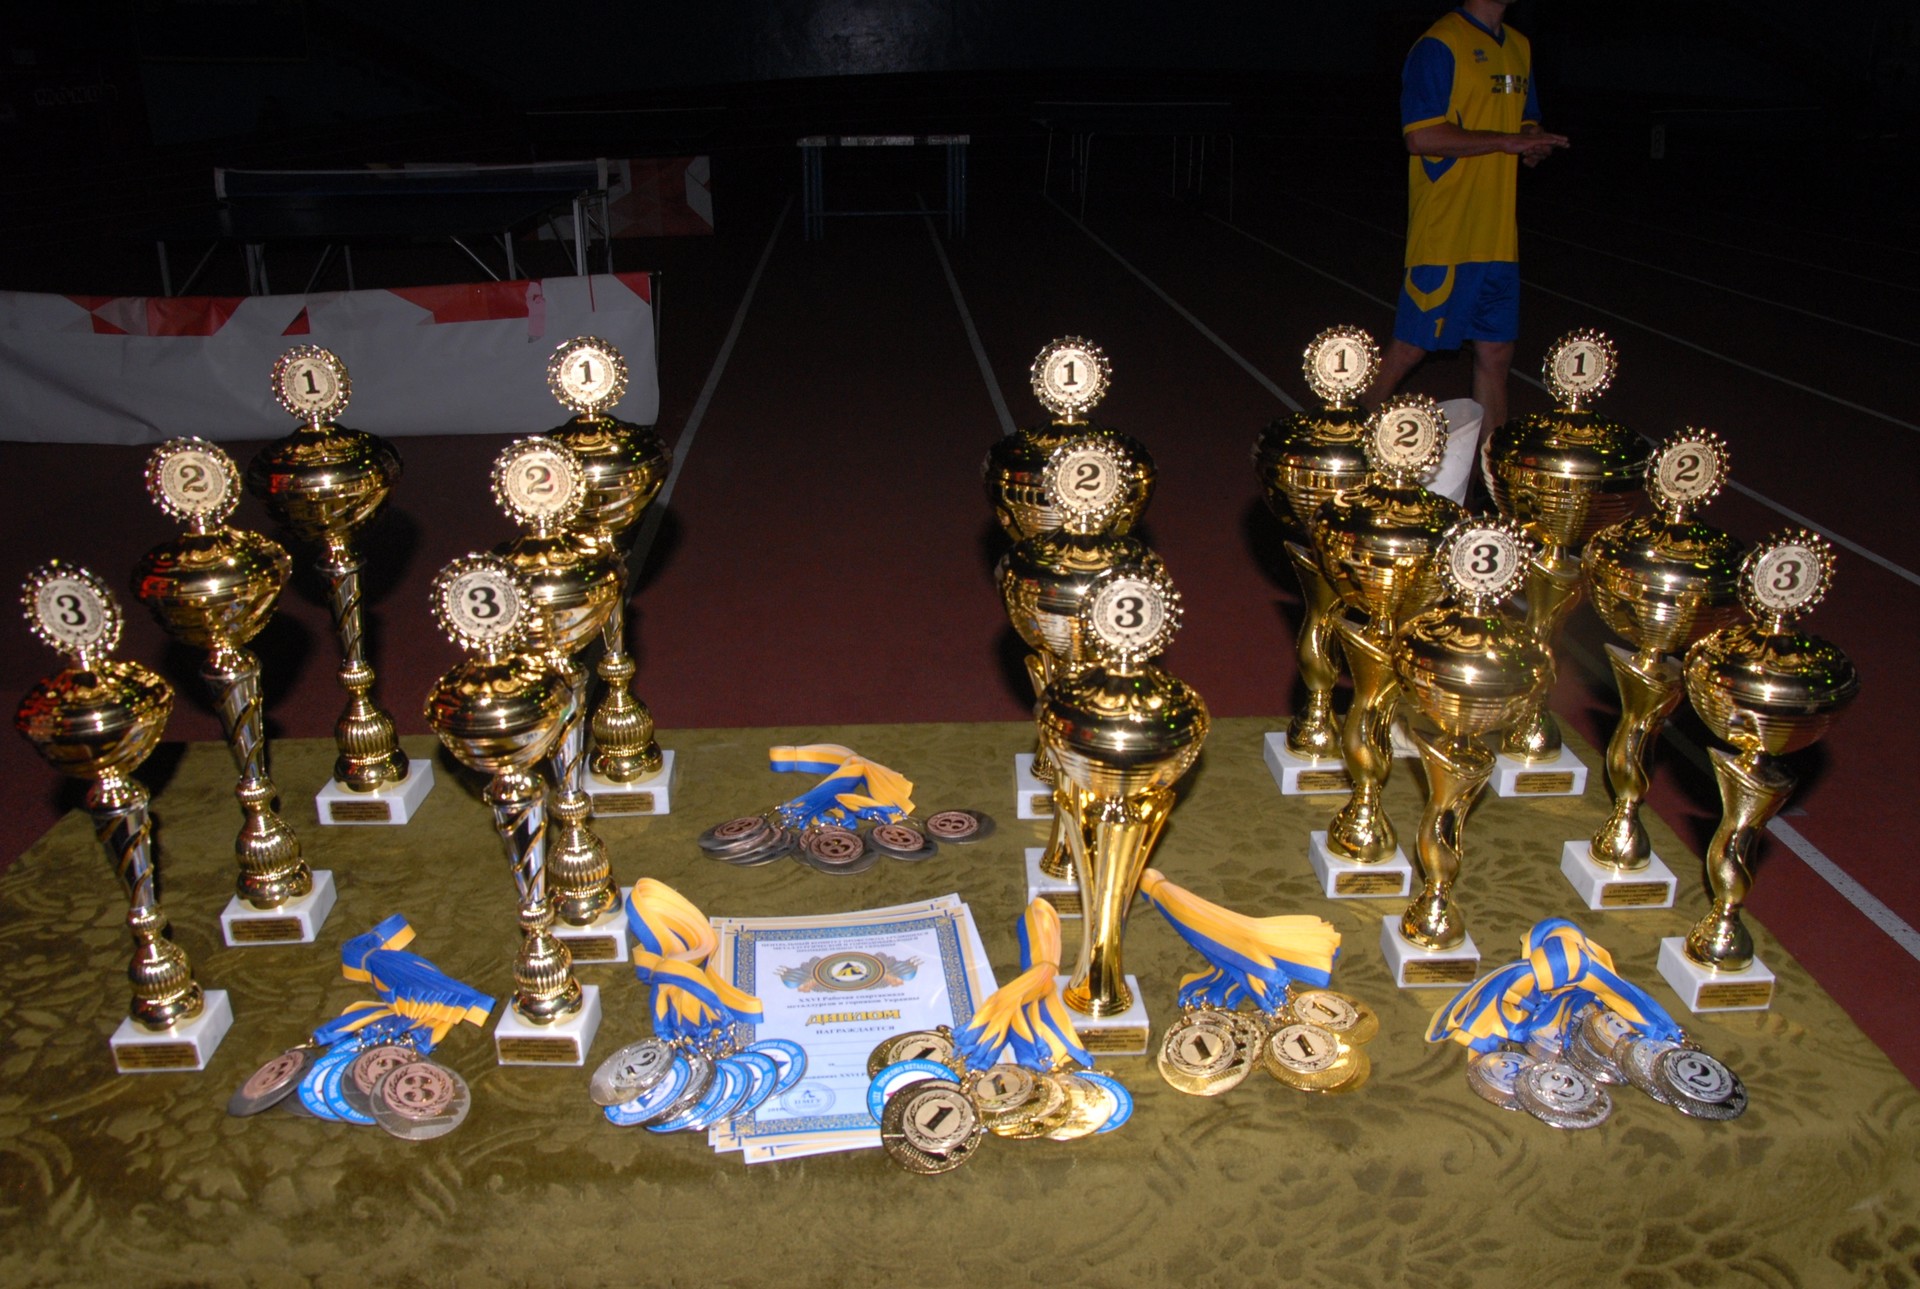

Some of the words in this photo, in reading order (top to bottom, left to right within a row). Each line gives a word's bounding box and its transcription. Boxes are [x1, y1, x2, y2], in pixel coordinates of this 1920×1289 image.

[1434, 317, 1446, 338] 1
[578, 360, 594, 385] 1
[1063, 361, 1079, 386] 1
[1334, 348, 1349, 373] 1
[1572, 352, 1587, 376] 1
[302, 369, 321, 395] 1
[1393, 420, 1420, 448] 2
[180, 464, 209, 493] 2
[525, 465, 554, 495] 2
[1074, 463, 1101, 491] 2
[1674, 454, 1700, 482] 2
[1471, 544, 1499, 574] 3
[1772, 560, 1802, 591] 3
[57, 594, 87, 626] 3
[468, 586, 501, 619] 3
[1114, 597, 1145, 628] 3
[805, 1009, 902, 1027] ДИПЛОМ
[1311, 1001, 1340, 1020] 1
[1190, 1034, 1213, 1061] 1
[1292, 1034, 1316, 1057] 1
[989, 1074, 1007, 1096] 1
[1551, 1072, 1576, 1098] 2
[1688, 1061, 1711, 1087] 2
[921, 1105, 954, 1133] 1
